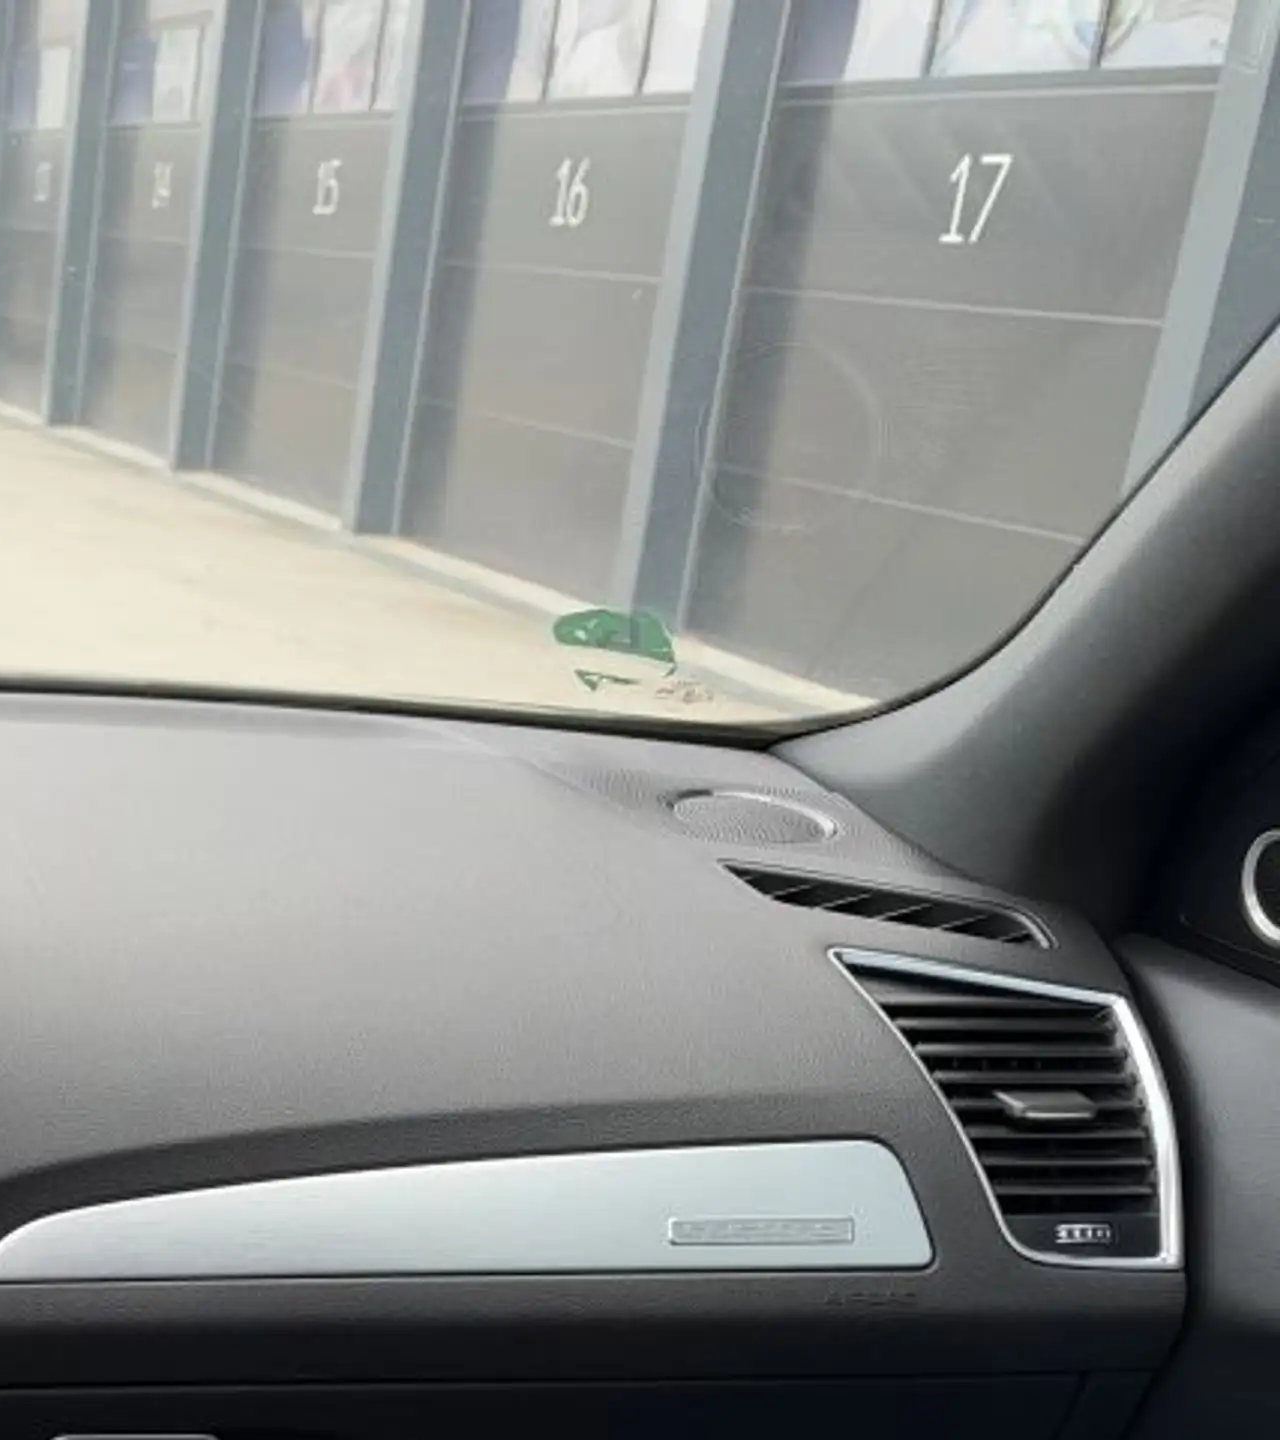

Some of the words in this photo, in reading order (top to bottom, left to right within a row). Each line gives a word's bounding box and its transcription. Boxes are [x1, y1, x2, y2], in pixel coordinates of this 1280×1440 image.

[312, 158, 342, 216] 15
[548, 156, 590, 228] 16
[938, 152, 1014, 244] 17
